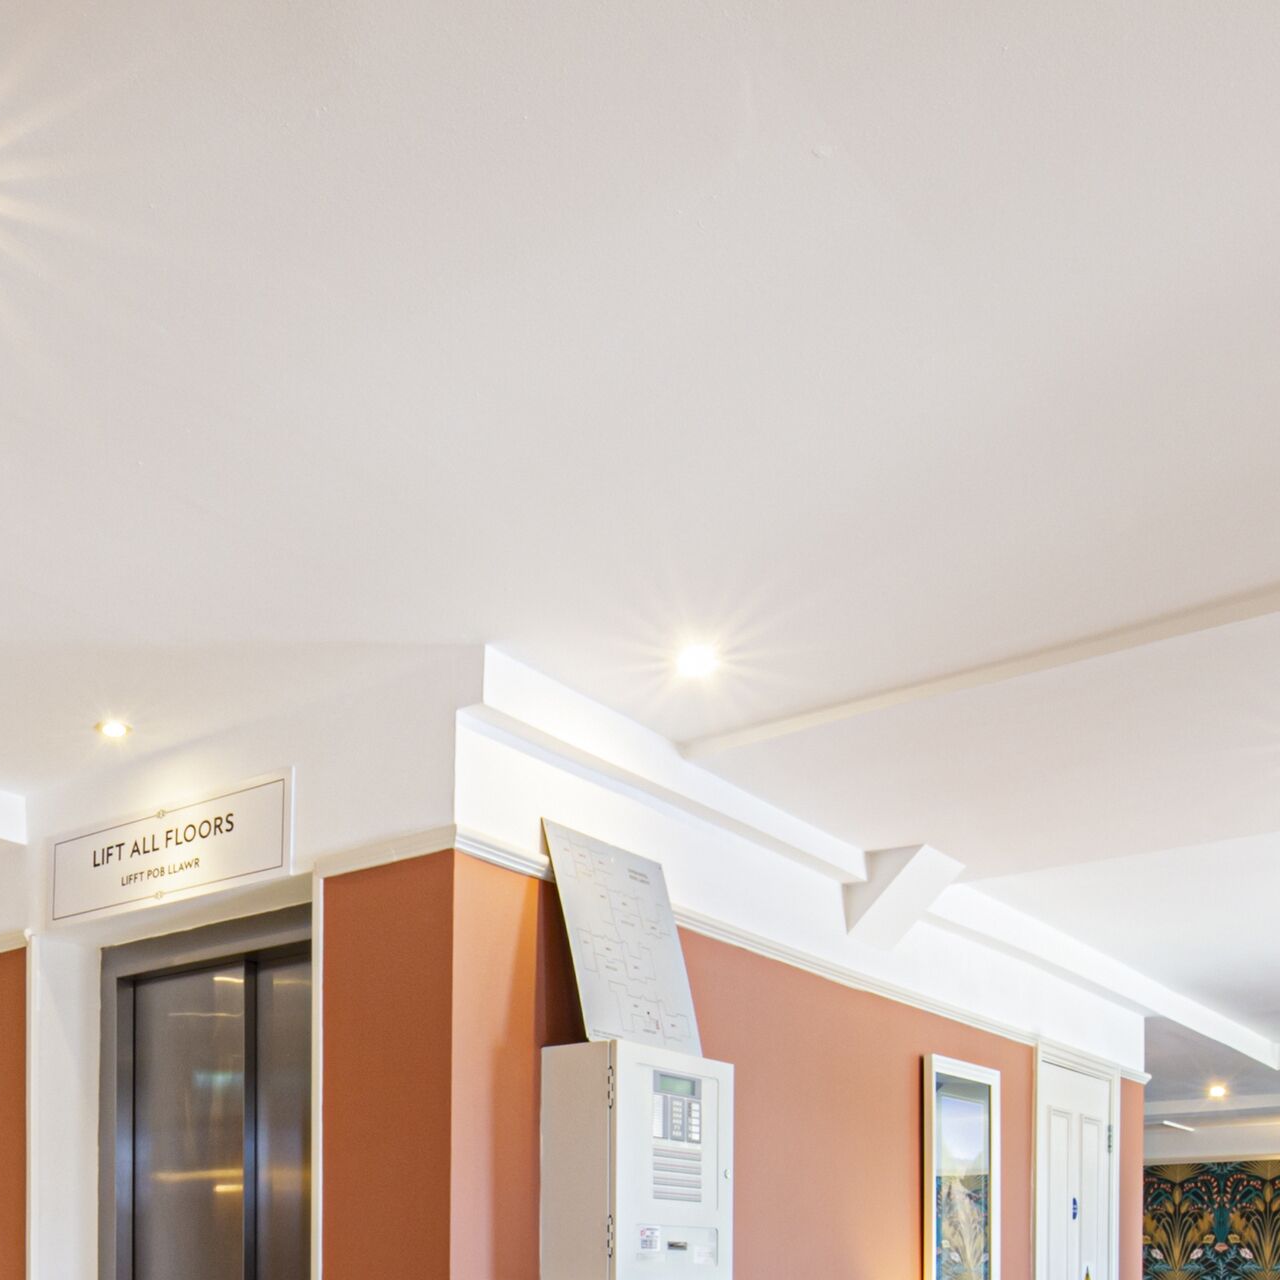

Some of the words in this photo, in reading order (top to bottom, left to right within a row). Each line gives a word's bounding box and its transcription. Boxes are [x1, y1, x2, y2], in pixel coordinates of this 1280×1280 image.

[93, 842, 125, 868] LIFT
[130, 834, 160, 858] ALL
[165, 813, 235, 849] FLOORS
[121, 871, 145, 887] LIFFT
[147, 865, 165, 881] POB
[168, 857, 200, 875] LLAWR
